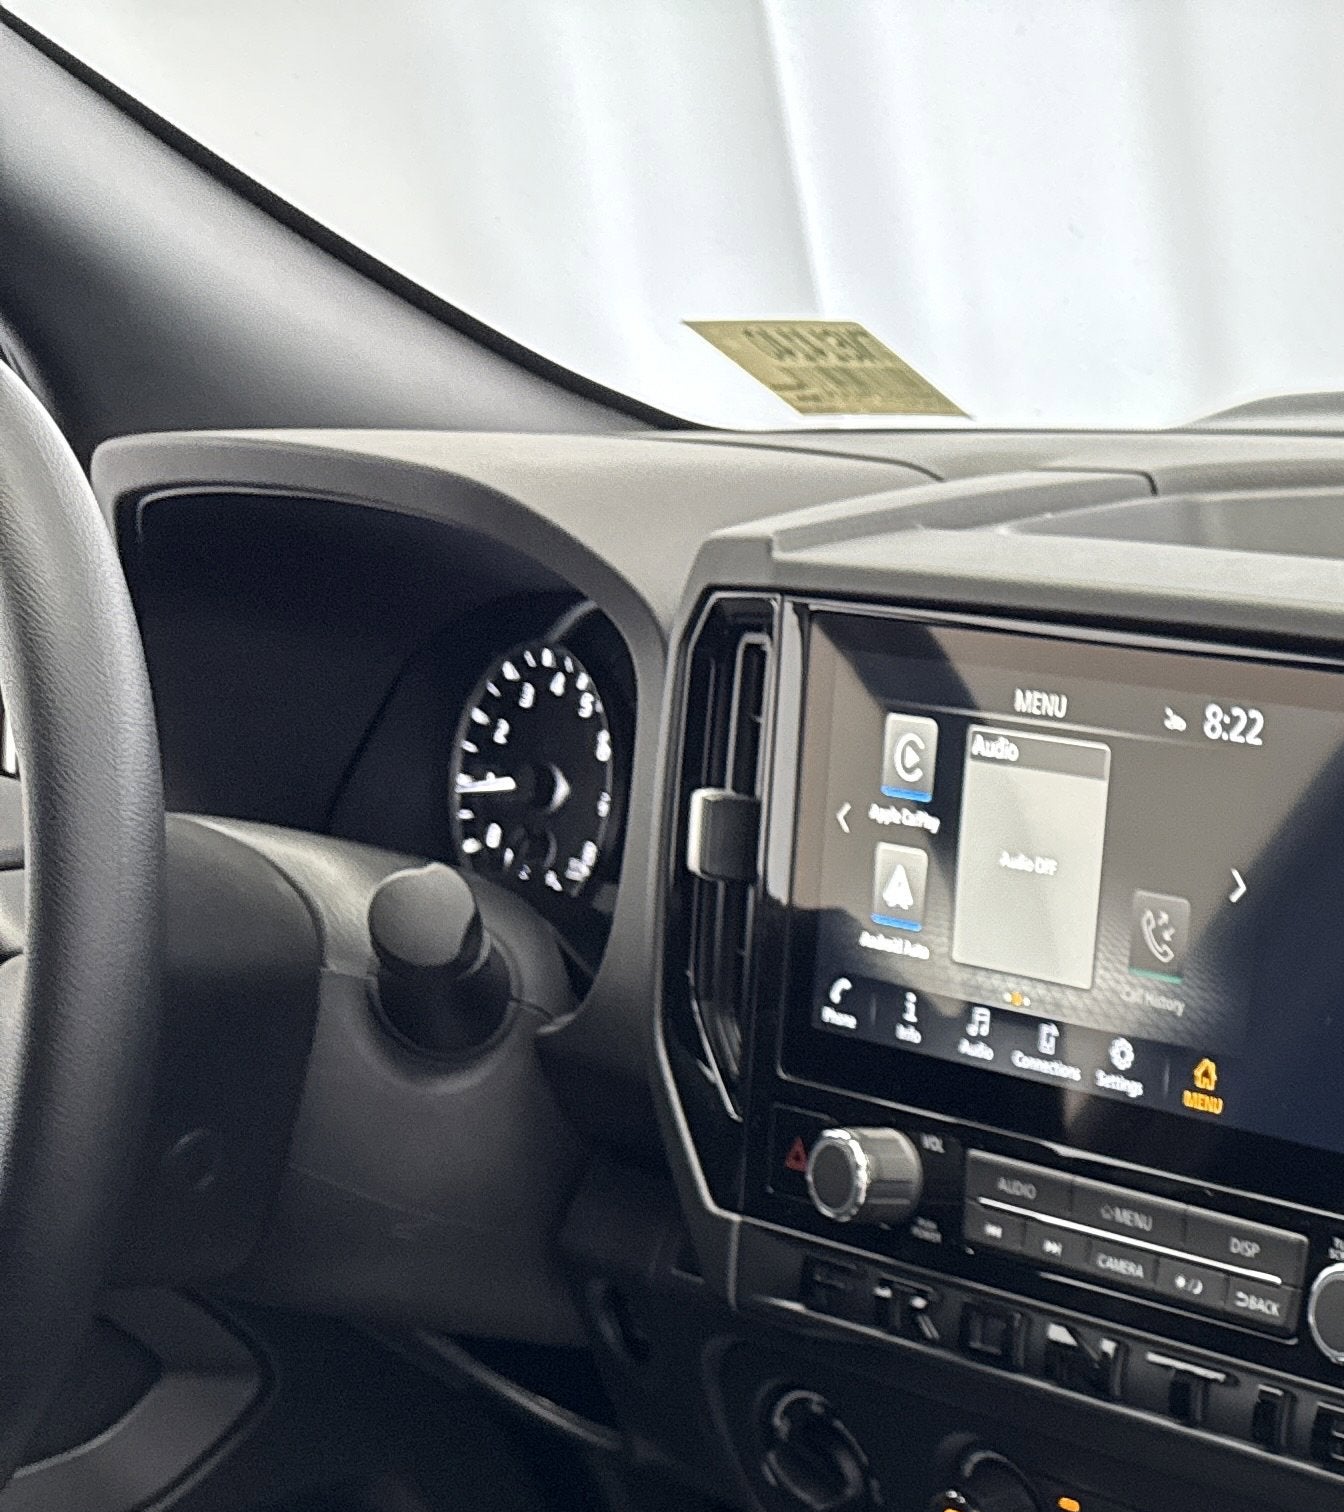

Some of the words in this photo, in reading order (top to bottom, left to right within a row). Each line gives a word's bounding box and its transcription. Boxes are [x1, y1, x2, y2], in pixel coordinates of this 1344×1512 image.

[1014, 688, 1067, 718] MENU
[1203, 703, 1265, 746] 8:22
[971, 734, 1019, 762] Audio
[999, 851, 1034, 873] Audio
[821, 1006, 857, 1029] Phone
[895, 1023, 921, 1044] Info
[957, 1038, 994, 1061] Audio
[1011, 1050, 1081, 1082] Connections
[1096, 1069, 1143, 1098] Settings
[1182, 1089, 1224, 1115] MENU
[919, 1132, 946, 1154] VOL
[997, 1176, 1037, 1200] AUDIO
[1114, 1206, 1153, 1232] MENU
[1229, 1236, 1261, 1259] DISP
[1097, 1253, 1145, 1280] CAMERA
[1248, 1293, 1281, 1318] BACK
